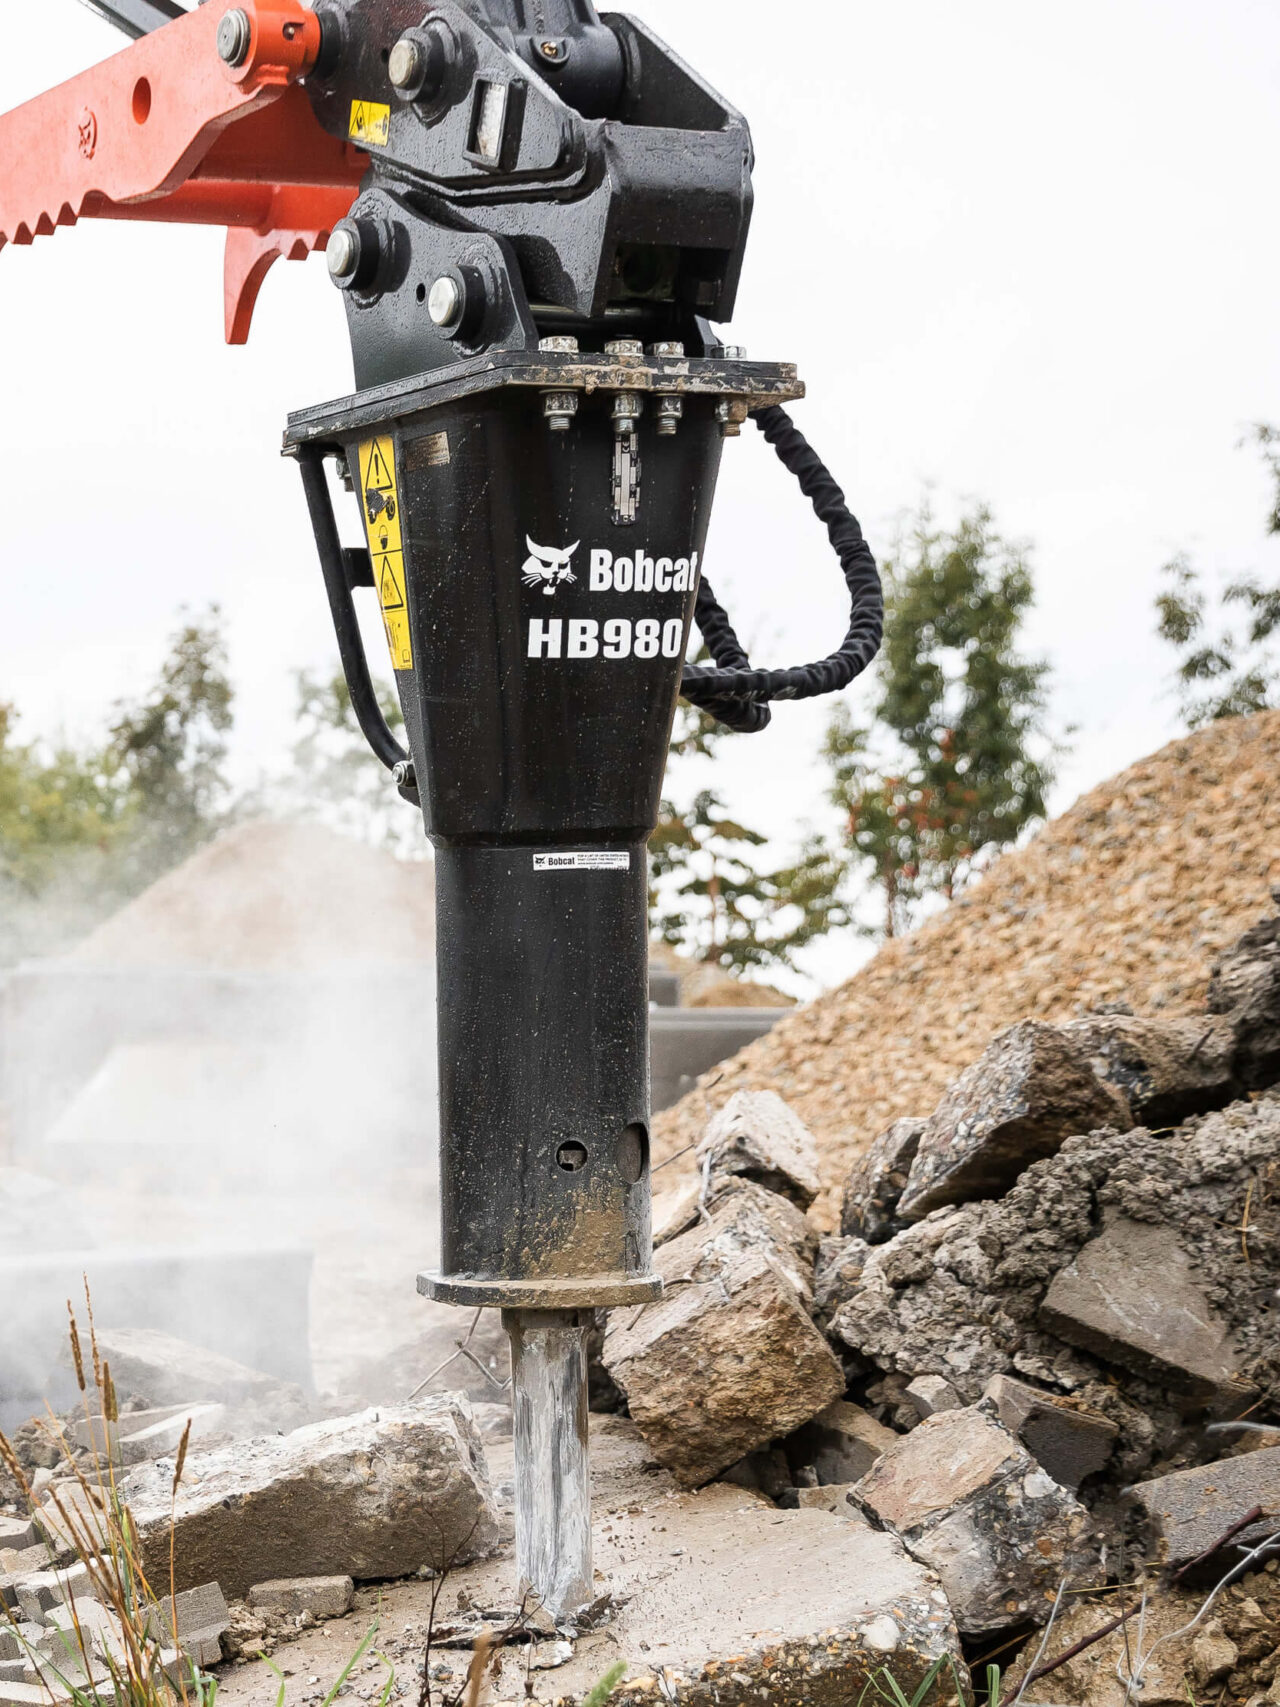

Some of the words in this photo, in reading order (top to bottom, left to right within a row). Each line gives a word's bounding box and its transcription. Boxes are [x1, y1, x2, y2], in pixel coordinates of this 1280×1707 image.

[589, 549, 698, 592] Bobcat
[527, 619, 683, 658] HB980
[548, 857, 575, 866] Bobcat
